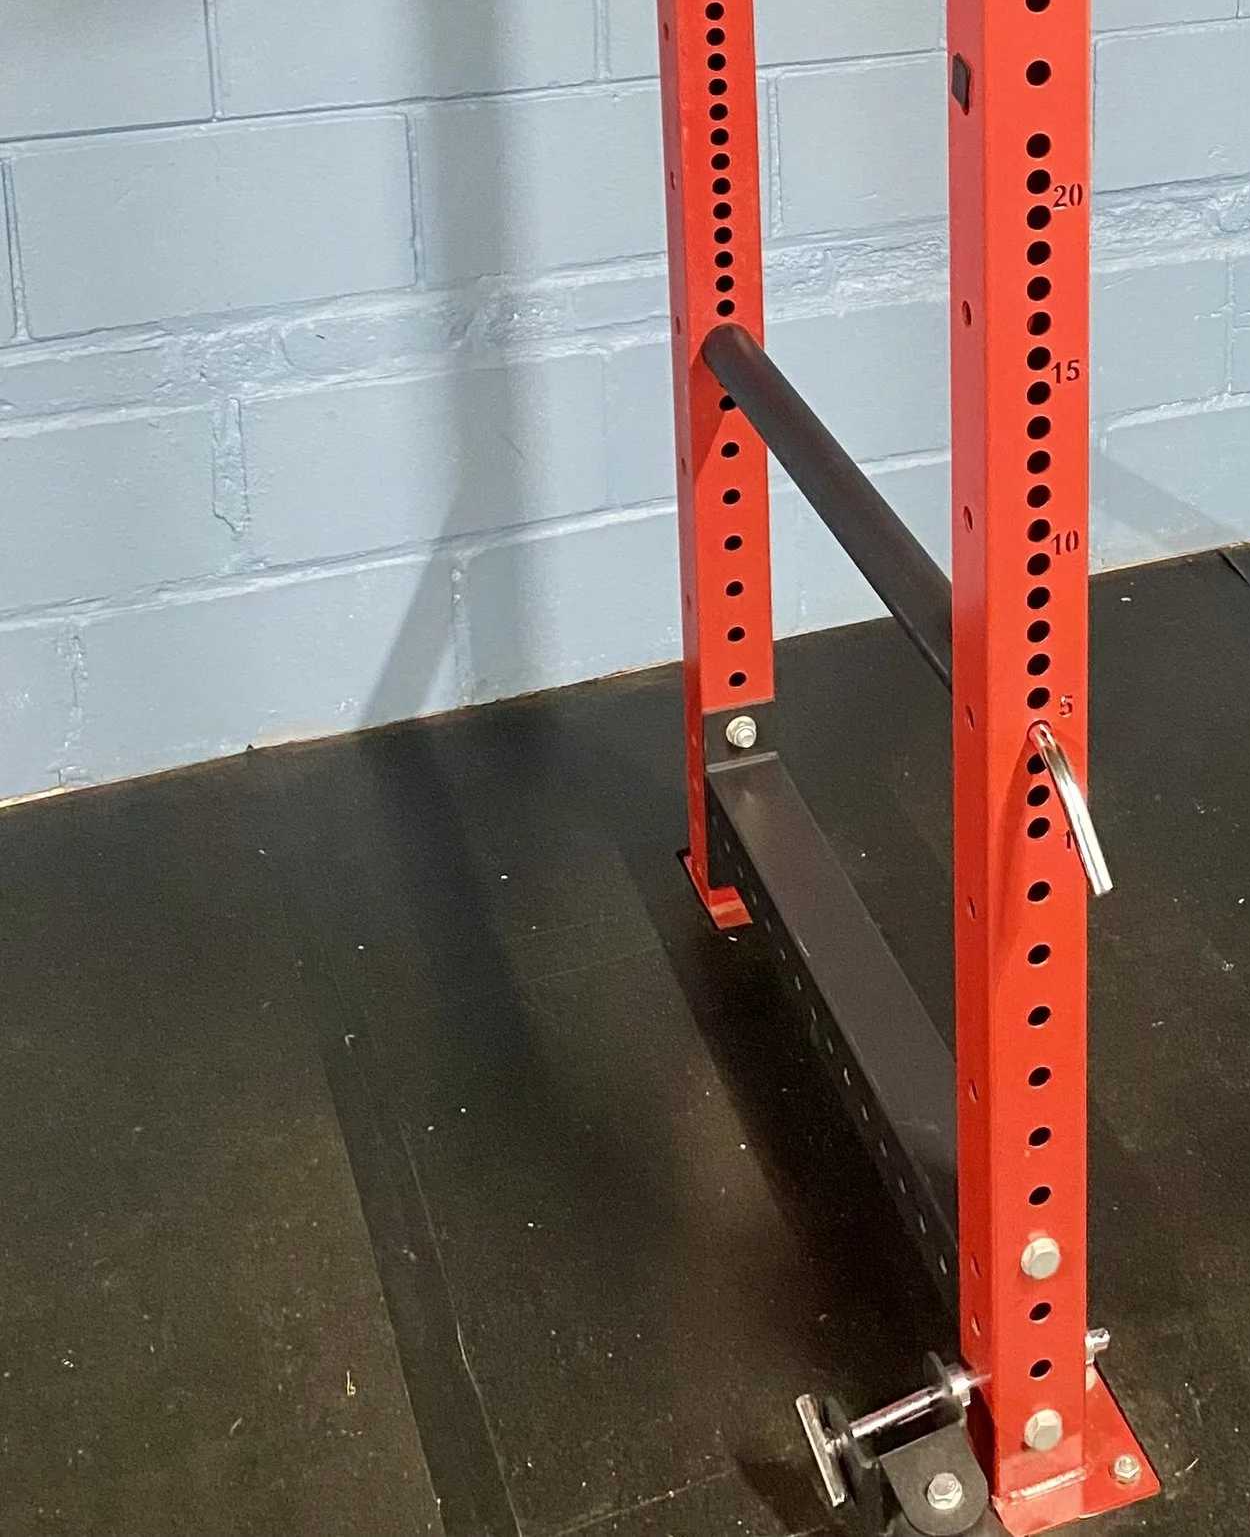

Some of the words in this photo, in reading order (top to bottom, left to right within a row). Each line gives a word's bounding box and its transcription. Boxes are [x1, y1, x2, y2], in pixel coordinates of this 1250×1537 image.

[1052, 183, 1083, 209] 20
[1050, 359, 1080, 384] 15
[1051, 530, 1079, 556] 10
[1058, 694, 1074, 718] 5
